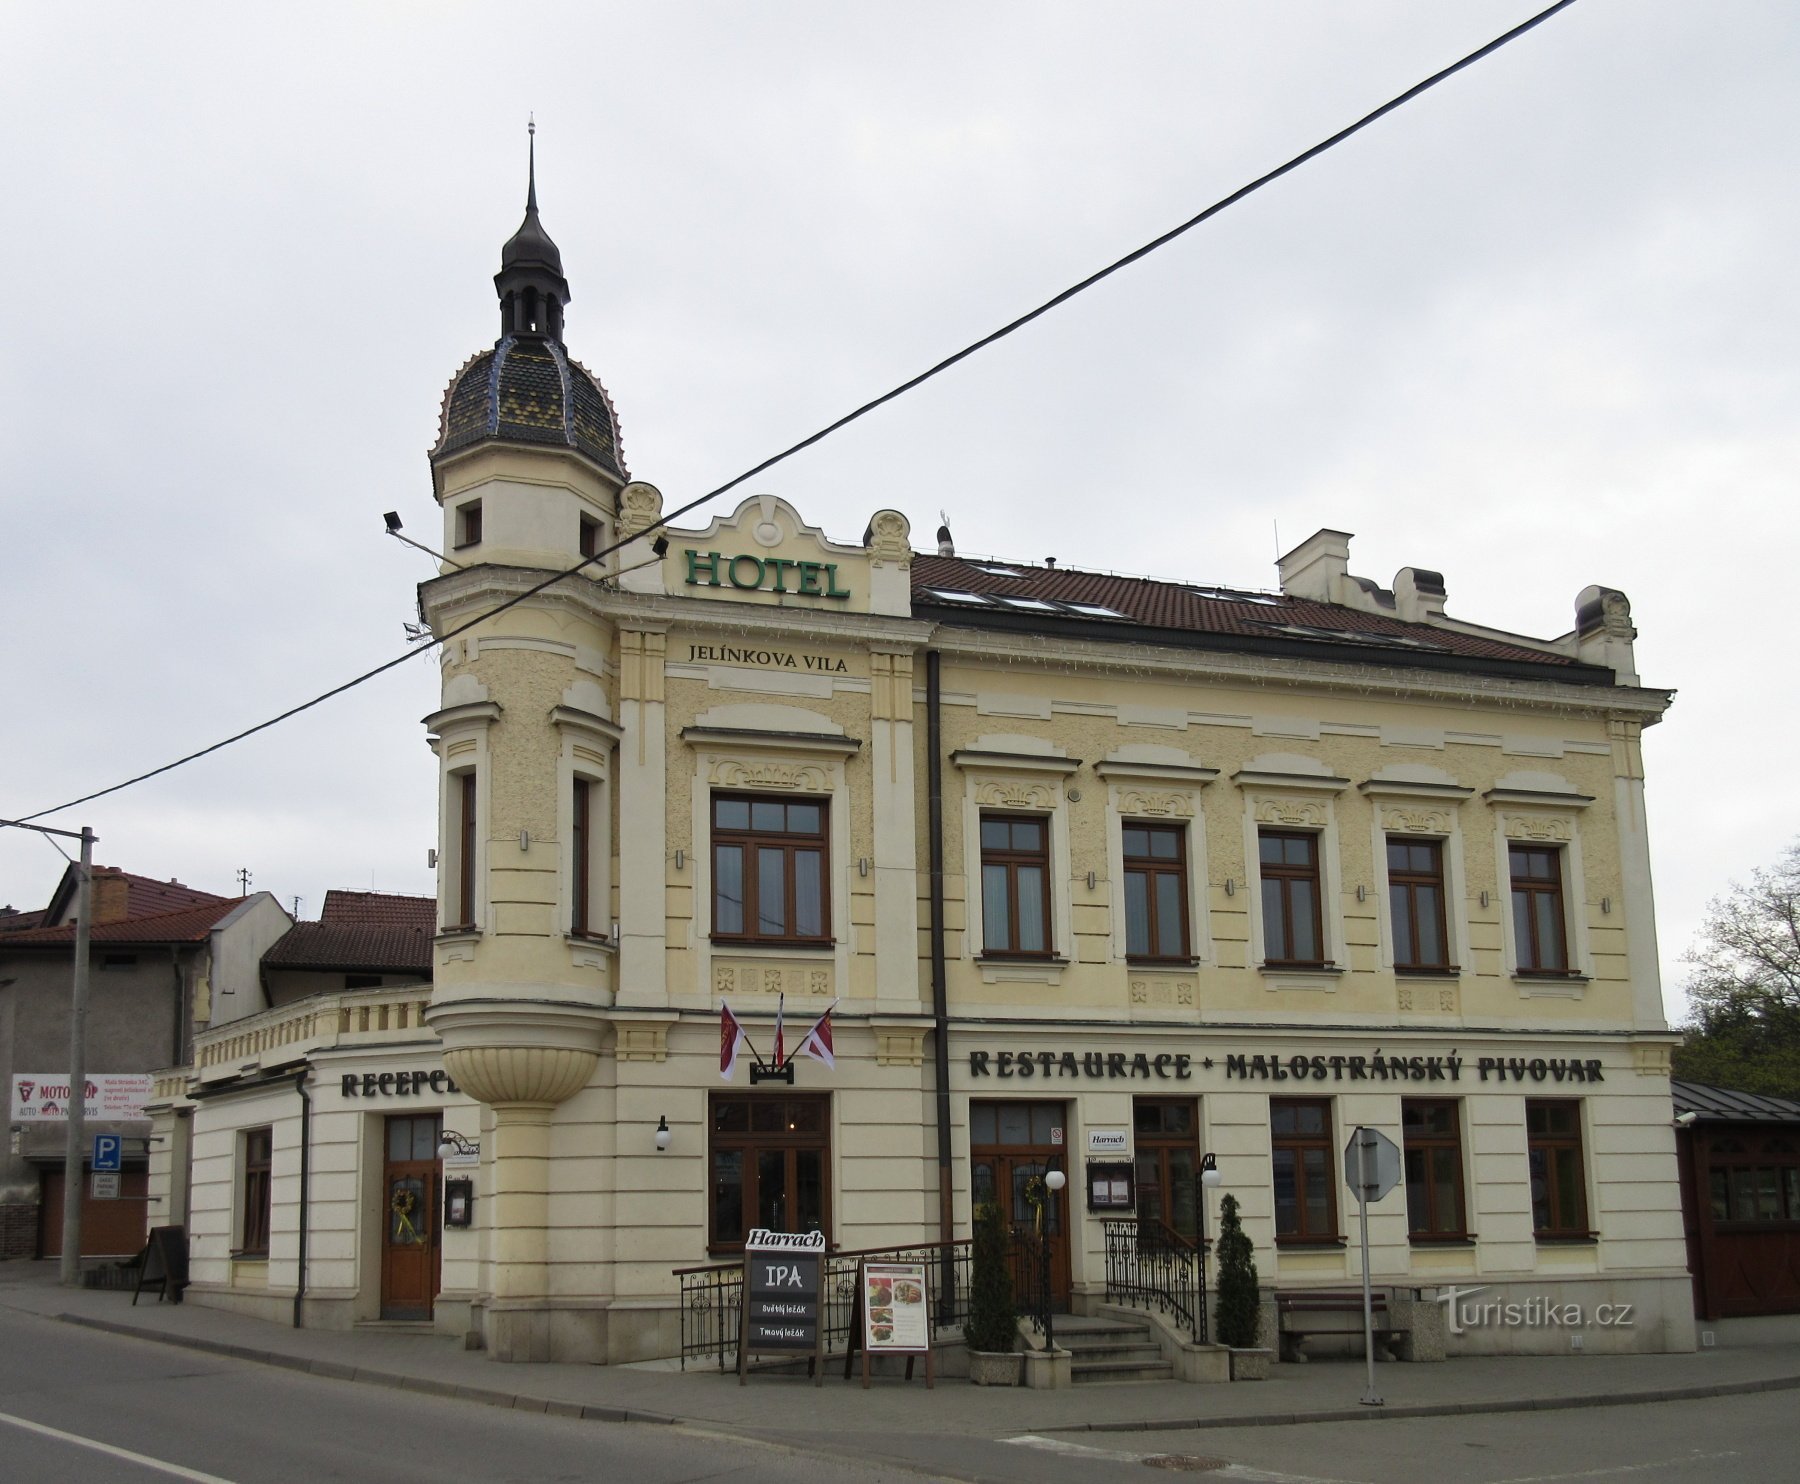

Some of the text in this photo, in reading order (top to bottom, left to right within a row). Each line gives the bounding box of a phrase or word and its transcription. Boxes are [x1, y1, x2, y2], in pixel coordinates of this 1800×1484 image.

[685, 550, 850, 598] HOTEL
[689, 644, 848, 672] JELÍNKOVA VILA
[970, 1048, 1604, 1082] RESTAURACE MALOSTRÁNSKÝ PIVOVAR
[40, 1086, 71, 1099] MOTO
[19, 1107, 36, 1116] AUTO
[99, 1138, 115, 1159] P
[749, 1230, 824, 1247] Harrach
[765, 1265, 803, 1288] IPA
[762, 1304, 806, 1315] Světlý ležák
[760, 1327, 805, 1338] Tmavý ležák
